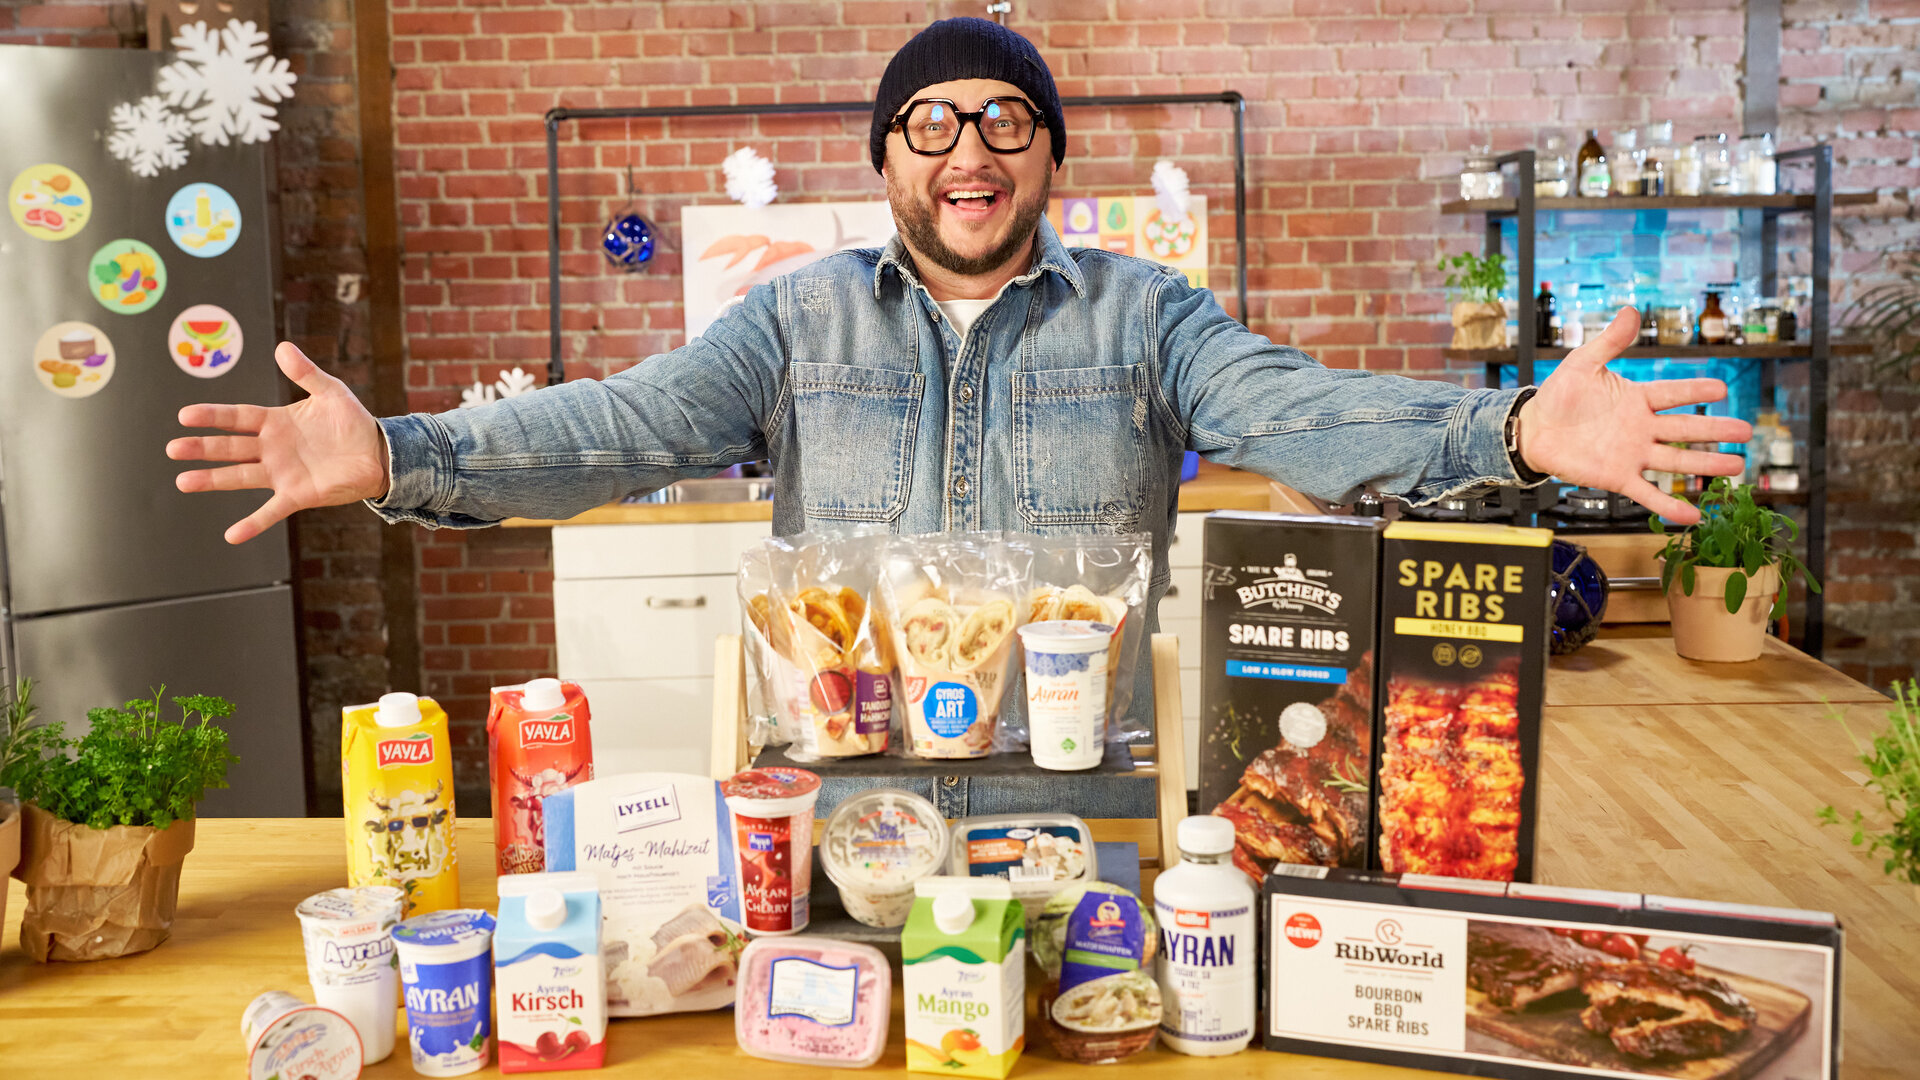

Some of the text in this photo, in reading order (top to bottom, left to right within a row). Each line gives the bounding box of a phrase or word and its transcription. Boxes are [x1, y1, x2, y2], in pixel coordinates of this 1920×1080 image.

[1398, 558, 1525, 594] SPARE
[1236, 582, 1342, 610] BUTCHER'S
[1415, 589, 1505, 622] RIBS
[1228, 623, 1350, 652] SPARE RIBS
[1430, 623, 1462, 635] HONEY
[1242, 665, 1261, 674] LOW
[1271, 667, 1294, 676] SLOW
[935, 687, 965, 700] GYROS
[1030, 685, 1079, 703] Ayran
[935, 700, 965, 718] ART
[525, 723, 571, 741] YAYLA
[381, 742, 430, 761] YAYLA
[618, 796, 670, 817] LYSELL
[745, 882, 788, 898] AYRAN
[745, 898, 790, 914] CHERRY
[1286, 926, 1321, 941] REWE
[323, 934, 395, 969] Ayran
[1157, 926, 1235, 968] AYRAN
[1334, 942, 1445, 970] RibWorld
[406, 981, 480, 1013] AYRAN
[537, 984, 570, 995] Ayran
[941, 986, 974, 999] Ayran
[1355, 984, 1423, 1004] BOURBON
[511, 988, 584, 1012] Kirsch
[917, 993, 990, 1022] Mango
[1374, 1002, 1403, 1019] BBQ
[1348, 1014, 1430, 1037] SPARE RIBS
